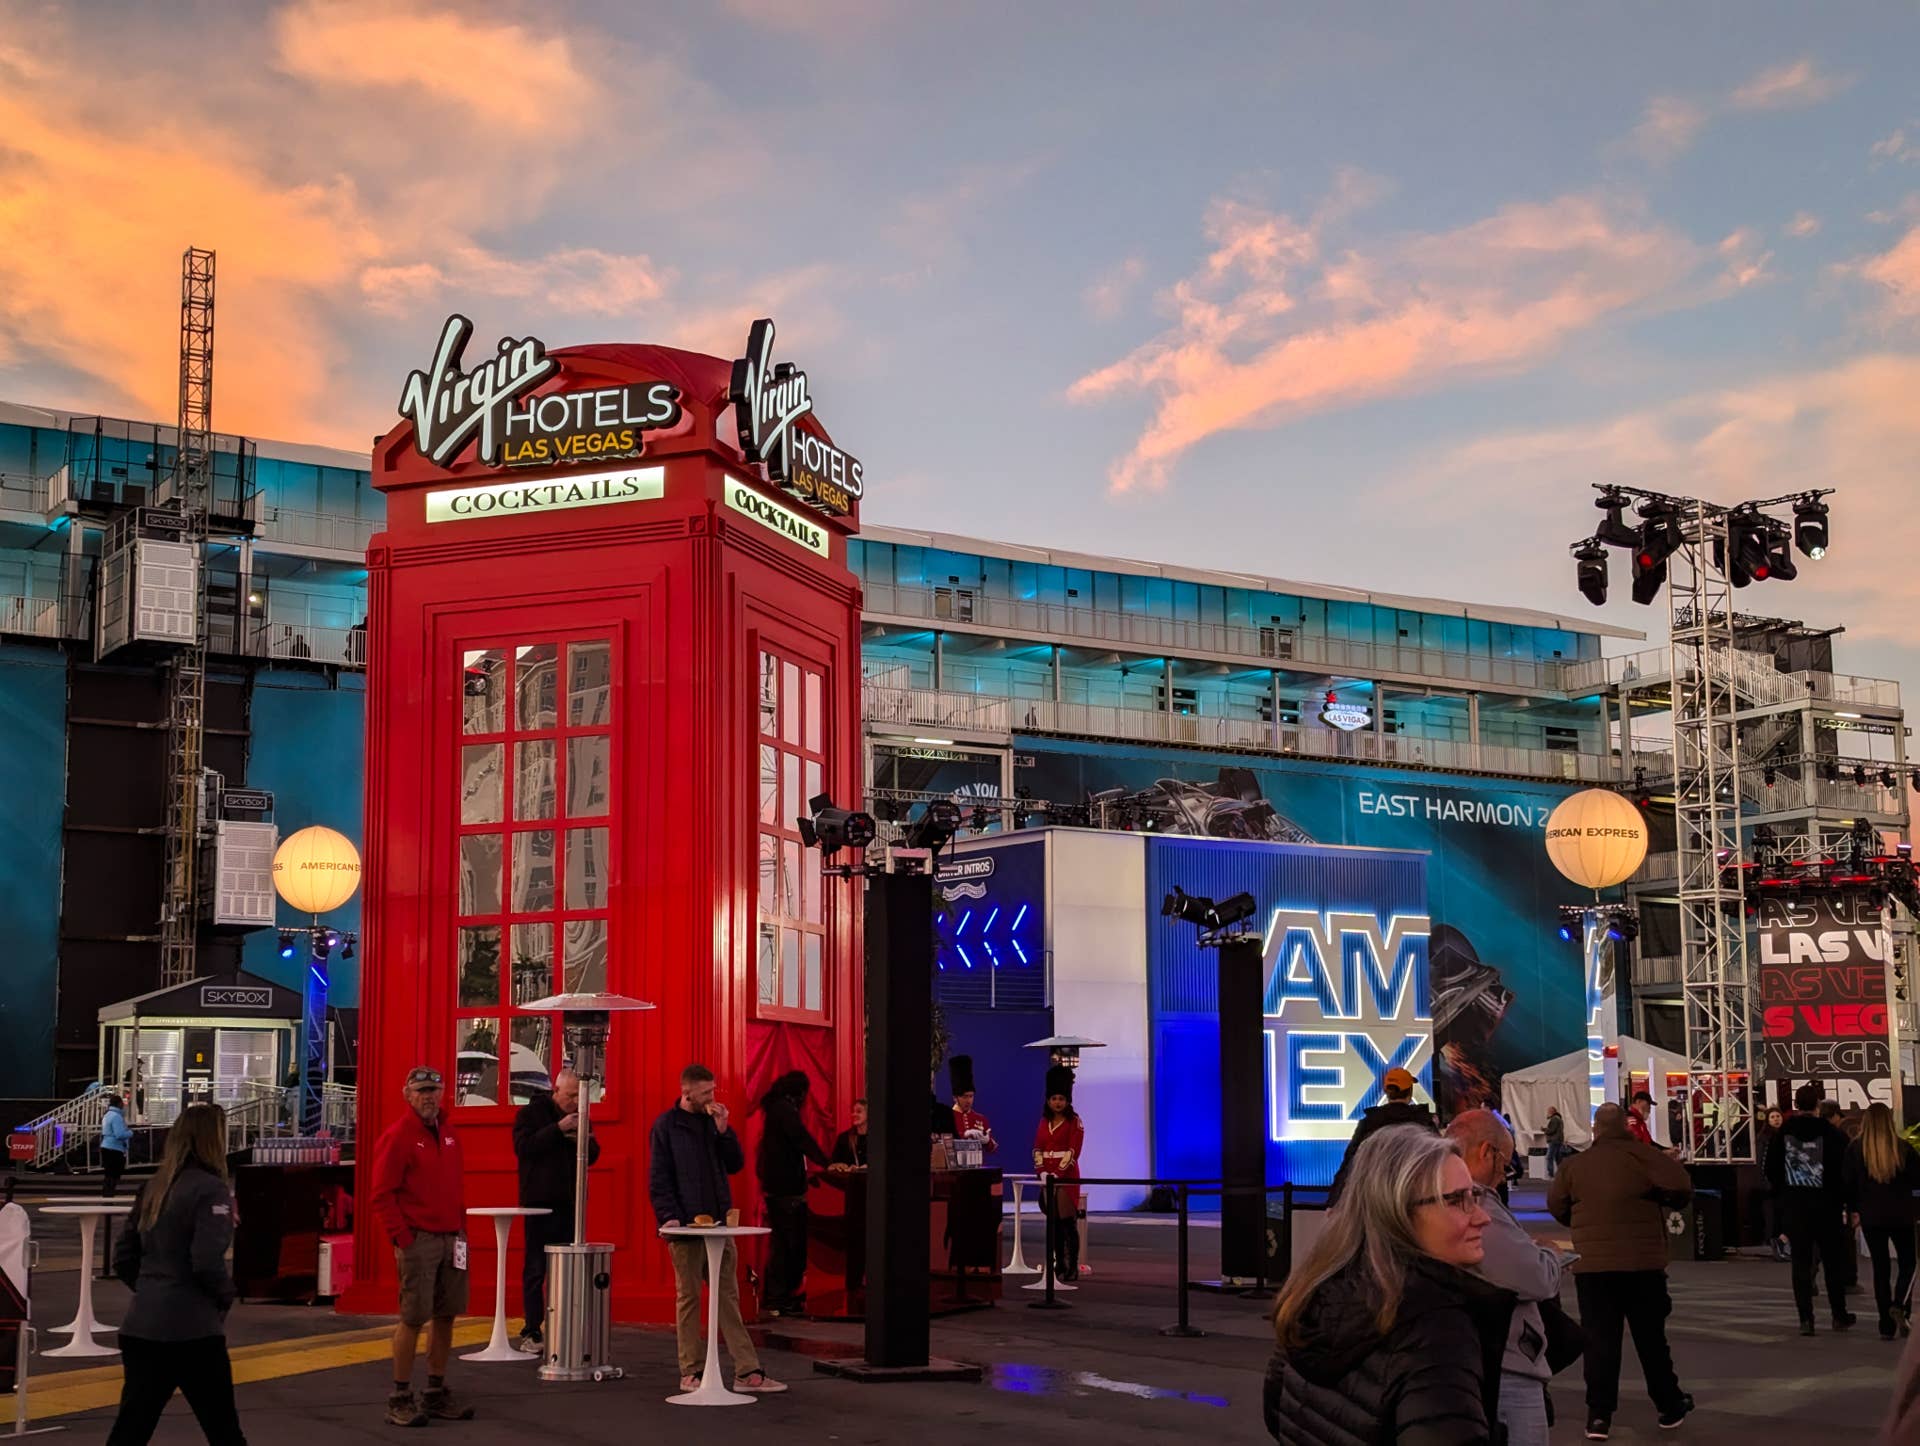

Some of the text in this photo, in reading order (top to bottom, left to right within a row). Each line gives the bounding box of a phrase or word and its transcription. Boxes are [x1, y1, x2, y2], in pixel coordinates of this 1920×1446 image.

[402, 318, 550, 461] Virgin
[744, 322, 812, 476] Virgin
[506, 385, 673, 436] HOTELS
[504, 430, 634, 461] LAS VEGAS
[792, 425, 862, 497] HOTELS
[451, 477, 639, 514] COCKTAILS
[792, 464, 849, 512] LAS VEGAS
[735, 489, 820, 549] COCKTAILS
[227, 797, 263, 806] SKYBOX
[1359, 792, 1552, 827] EAST HARMON 2
[1546, 828, 1639, 839] ERICAN EXPRESS
[300, 862, 354, 871] AMERICAN
[964, 862, 990, 875] INTROS
[1760, 931, 1850, 964] LAS
[207, 991, 266, 1003] SKYBOX
[1762, 1006, 1795, 1037] S
